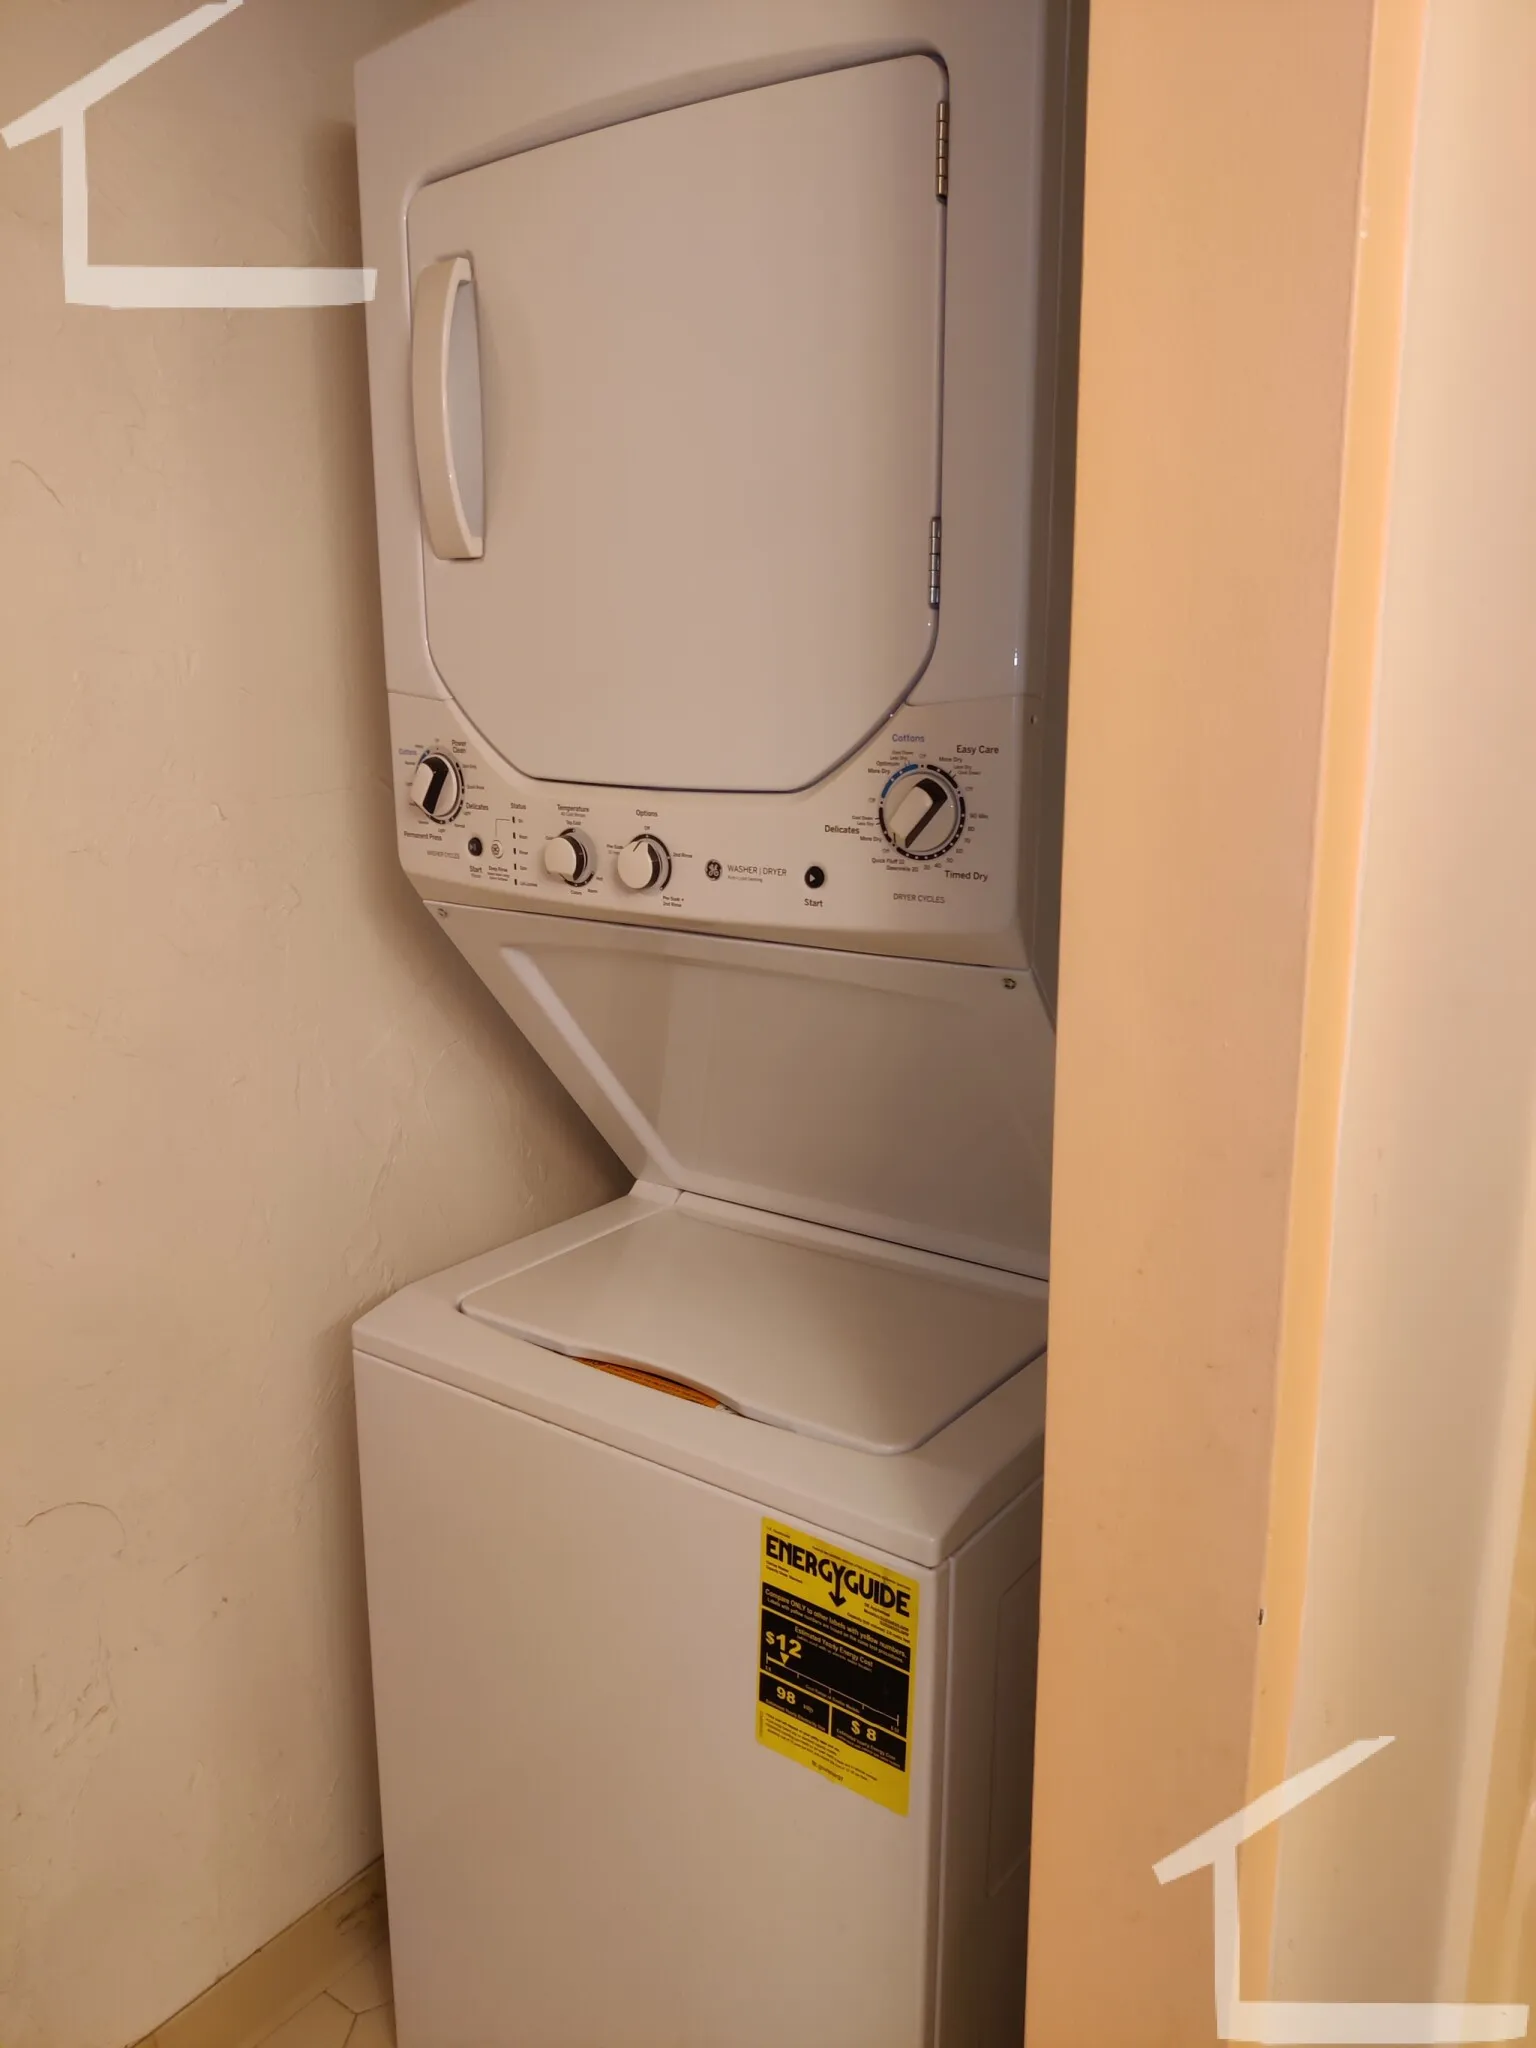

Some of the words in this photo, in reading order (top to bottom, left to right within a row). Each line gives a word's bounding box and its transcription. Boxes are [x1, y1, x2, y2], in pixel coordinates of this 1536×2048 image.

[892, 734, 924, 742] Cottons
[956, 744, 976, 755] Easy
[978, 745, 1000, 754] Care
[636, 809, 658, 818] Options
[824, 824, 860, 834] Delicates
[728, 865, 758, 874] WASHER
[762, 868, 787, 876] DRYER
[944, 870, 971, 880] Timed
[973, 872, 988, 882] Dry
[804, 898, 823, 908] Start
[893, 893, 916, 902] DRYER
[918, 894, 946, 904] CYCLES
[766, 1533, 910, 1618] ENERGYGUIDE
[765, 1588, 790, 1604] Compare
[791, 1600, 806, 1611] ONLY
[814, 1611, 828, 1622] other
[829, 1616, 846, 1630] labels
[846, 1626, 858, 1636] with
[860, 1632, 878, 1646] yellow
[766, 1631, 802, 1659] $12
[795, 1626, 821, 1643] Estimated
[822, 1638, 838, 1652] Yearly
[840, 1646, 858, 1662] Energy
[860, 1656, 873, 1668] Cost
[776, 1686, 796, 1704] 98
[850, 1720, 860, 1735] $
[866, 1728, 876, 1742] 8
